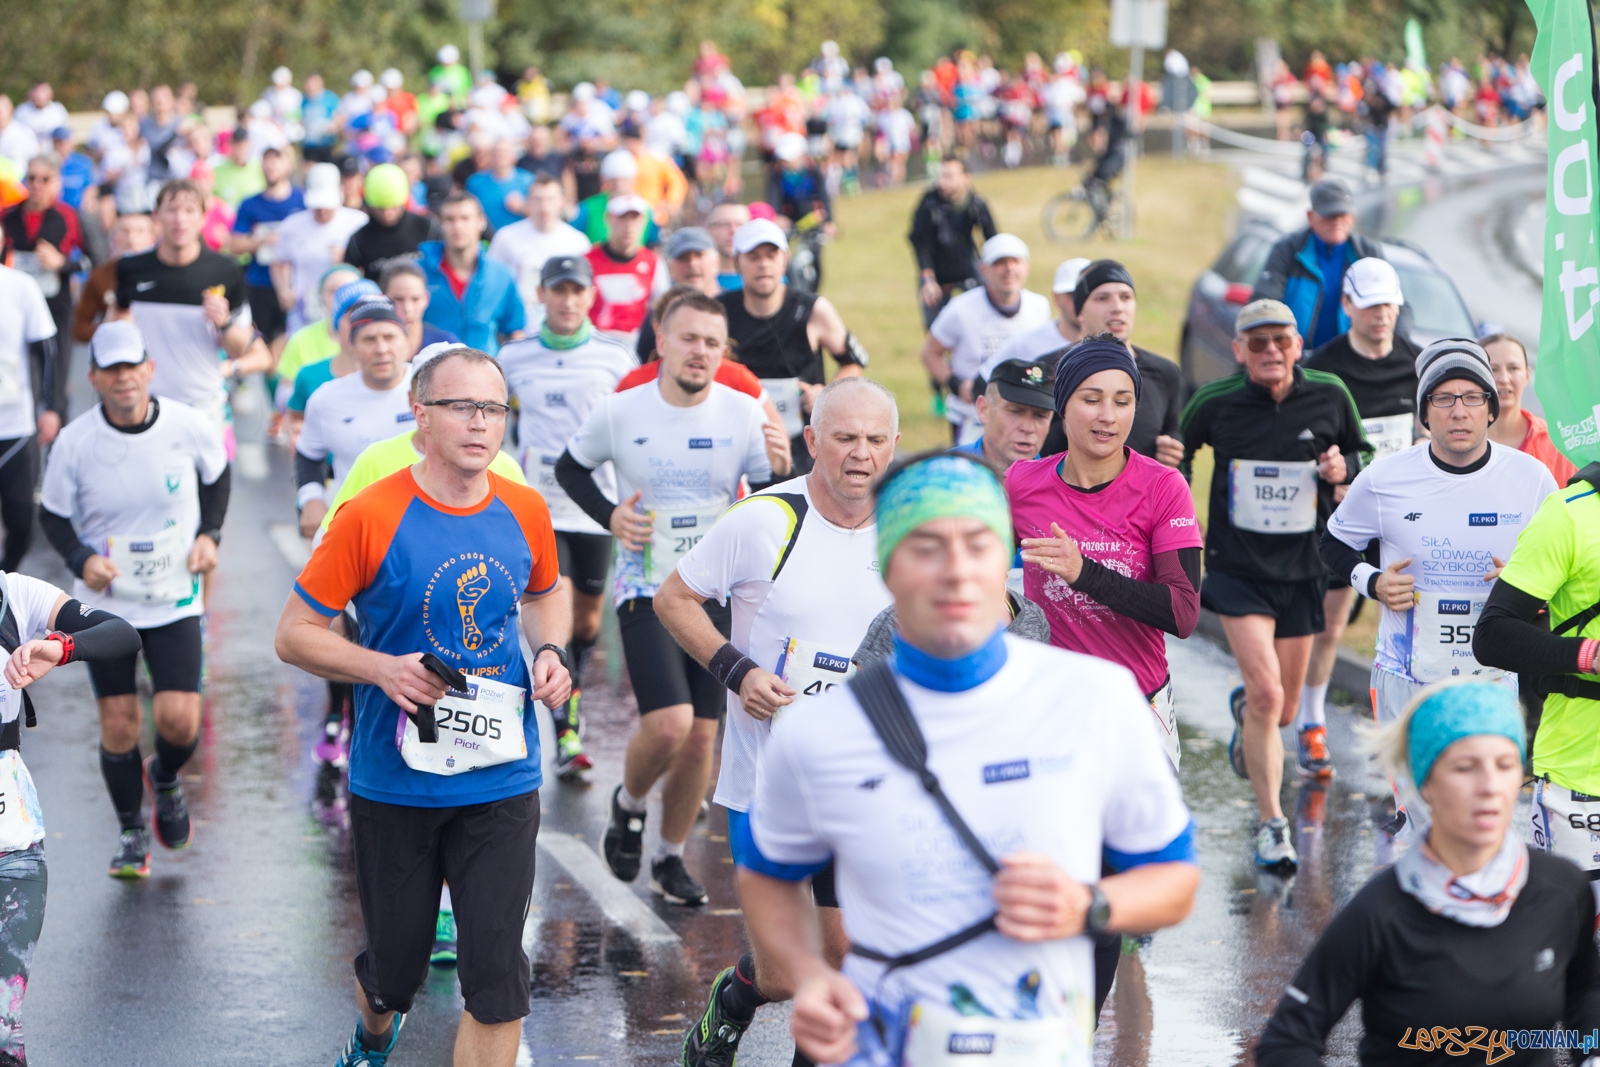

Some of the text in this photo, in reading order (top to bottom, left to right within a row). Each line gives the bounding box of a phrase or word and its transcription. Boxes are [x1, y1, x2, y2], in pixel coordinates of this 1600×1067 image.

[1254, 484, 1299, 501] 1847
[1403, 512, 1422, 521] 4F
[1481, 515, 1496, 523] PKO
[1080, 541, 1121, 552] POZOSTAŁ
[1421, 536, 1452, 547] SIŁA
[1431, 549, 1493, 560] ODWAGA
[133, 554, 172, 576] 2291
[1422, 559, 1493, 573] SZYBKOŚĆ
[423, 557, 456, 625] TOWARZYSTWO
[459, 551, 485, 561] OSÓB
[1430, 578, 1475, 587] października
[1441, 603, 1451, 611] 17.
[1452, 603, 1468, 611] PKO
[818, 656, 846, 669] 17. PKO
[437, 706, 502, 740] 2505
[454, 737, 481, 751] Piotr
